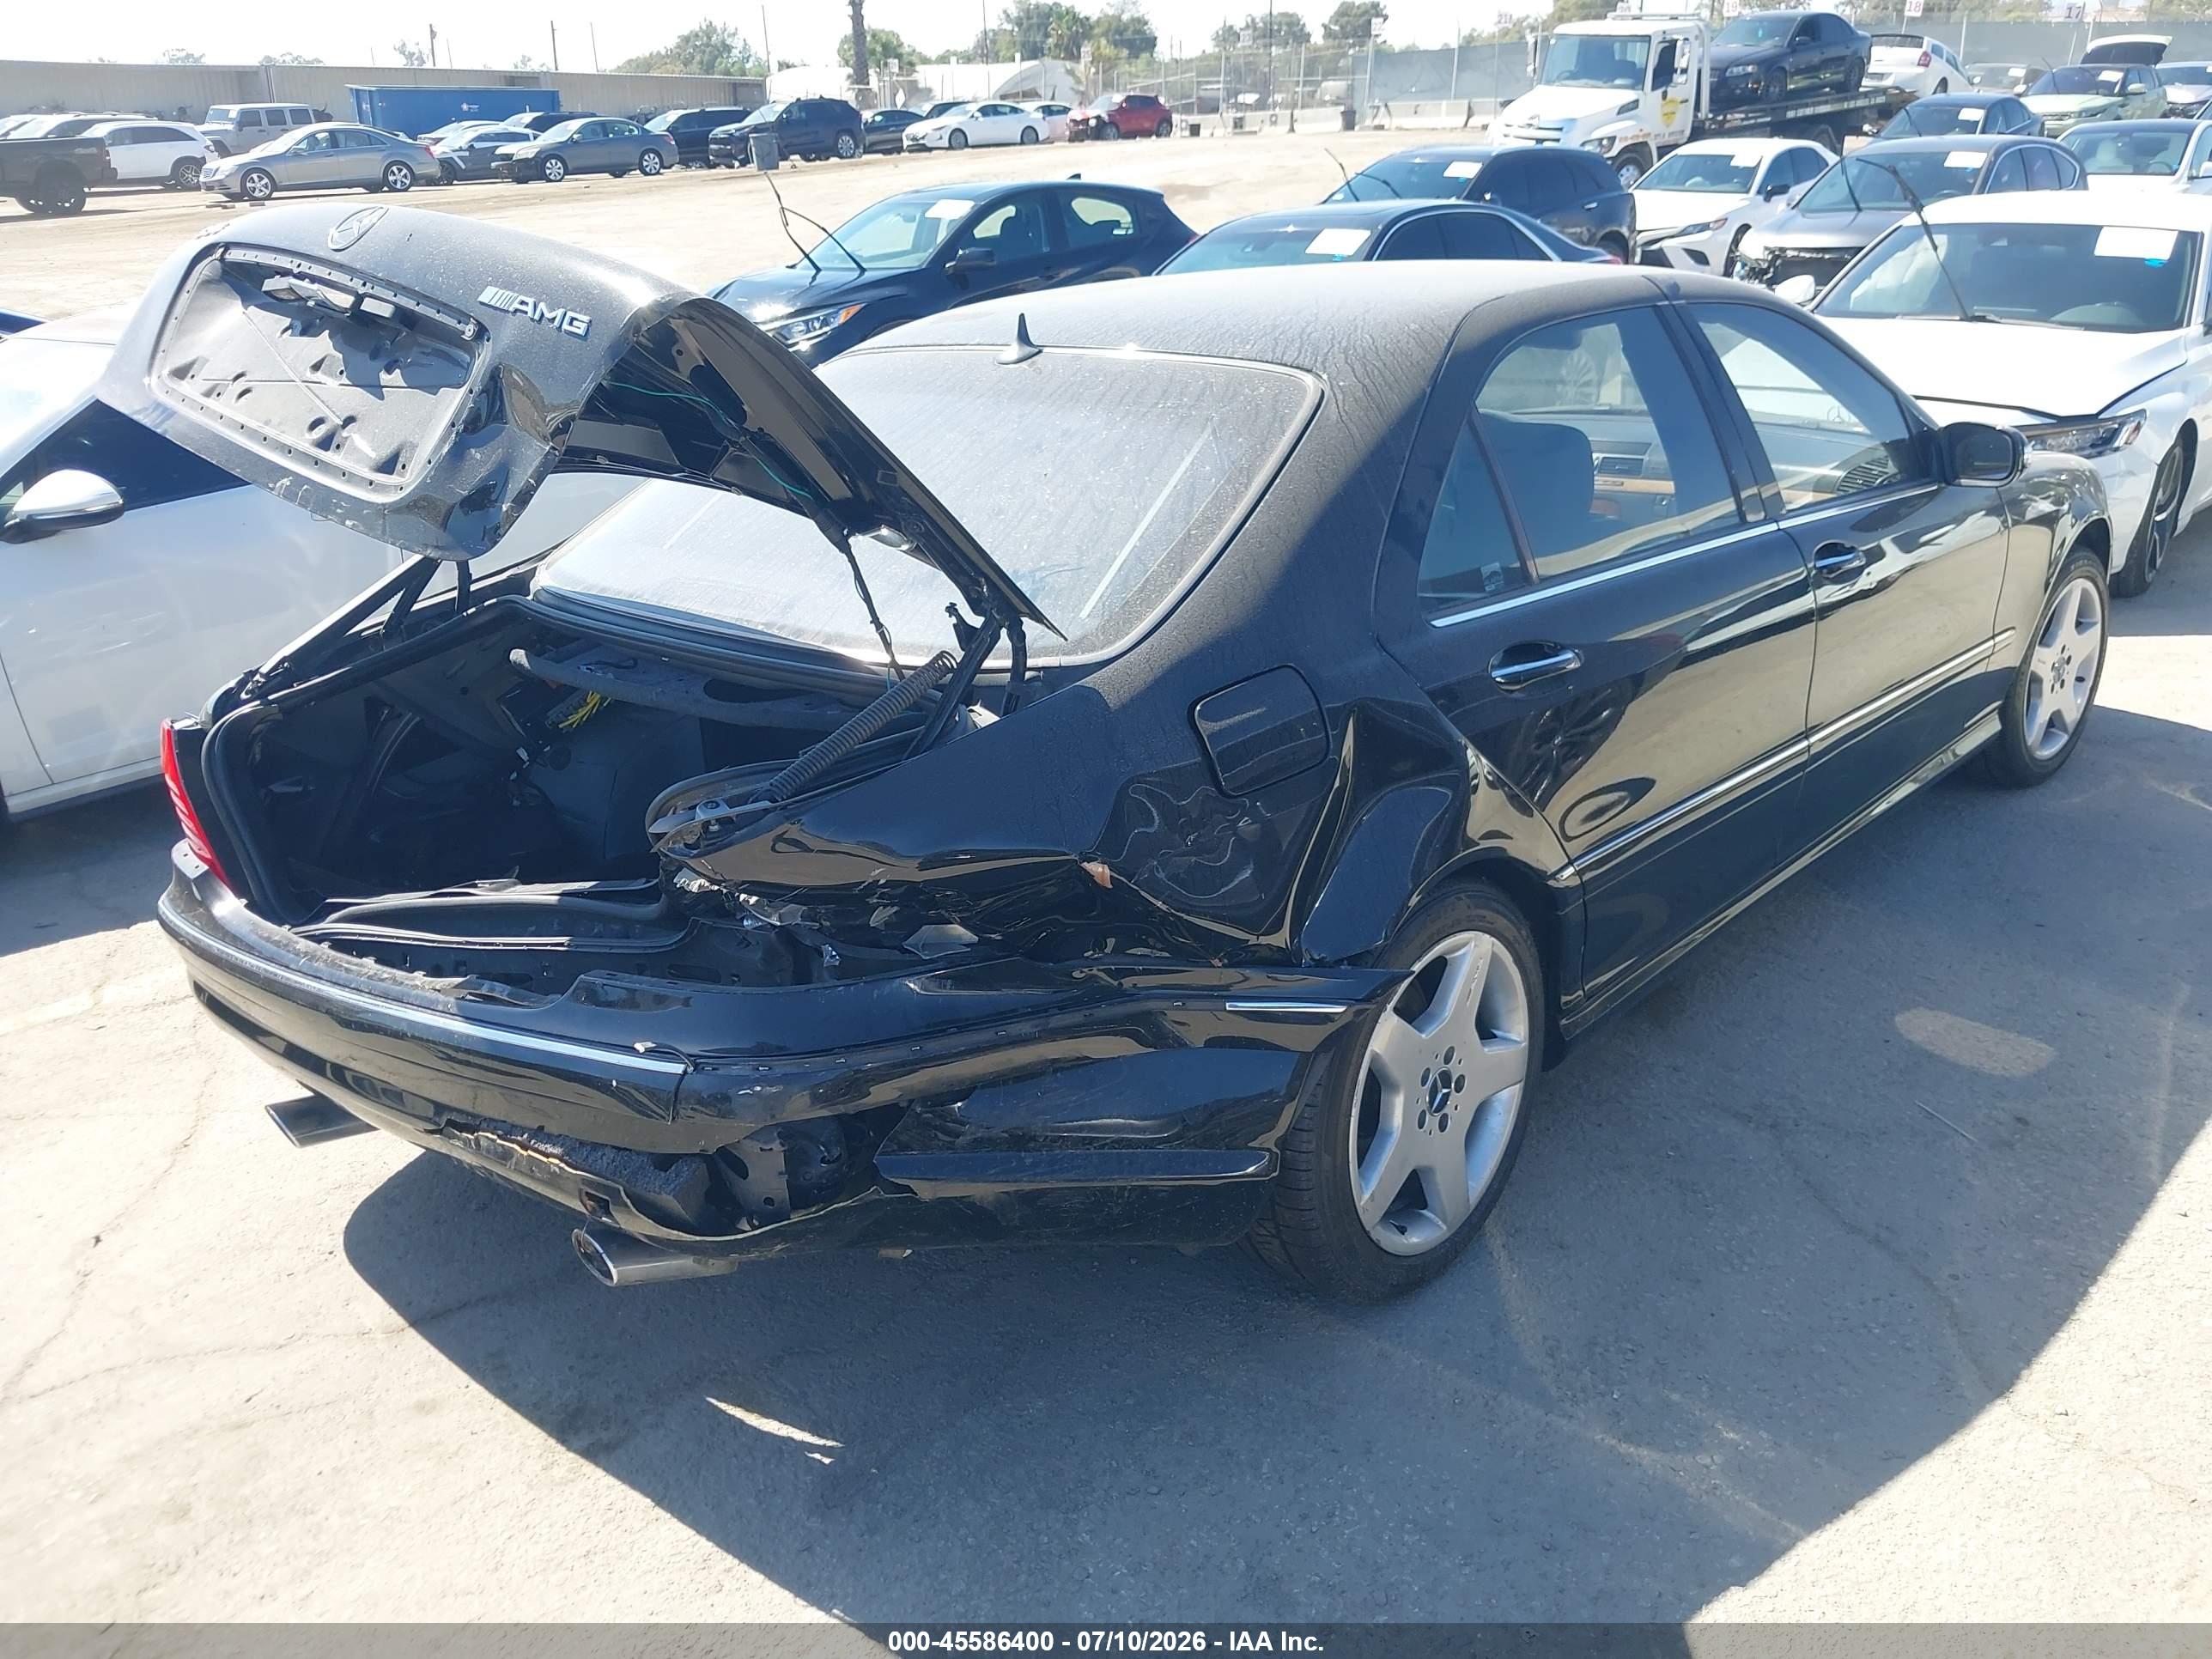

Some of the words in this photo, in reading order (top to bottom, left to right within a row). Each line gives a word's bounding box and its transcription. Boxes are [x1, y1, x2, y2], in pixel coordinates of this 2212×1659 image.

[1726, 1, 1738, 13] 19
[1907, 0, 1922, 13] 18
[2064, 6, 2082, 19] 17
[508, 294, 592, 337] AMG
